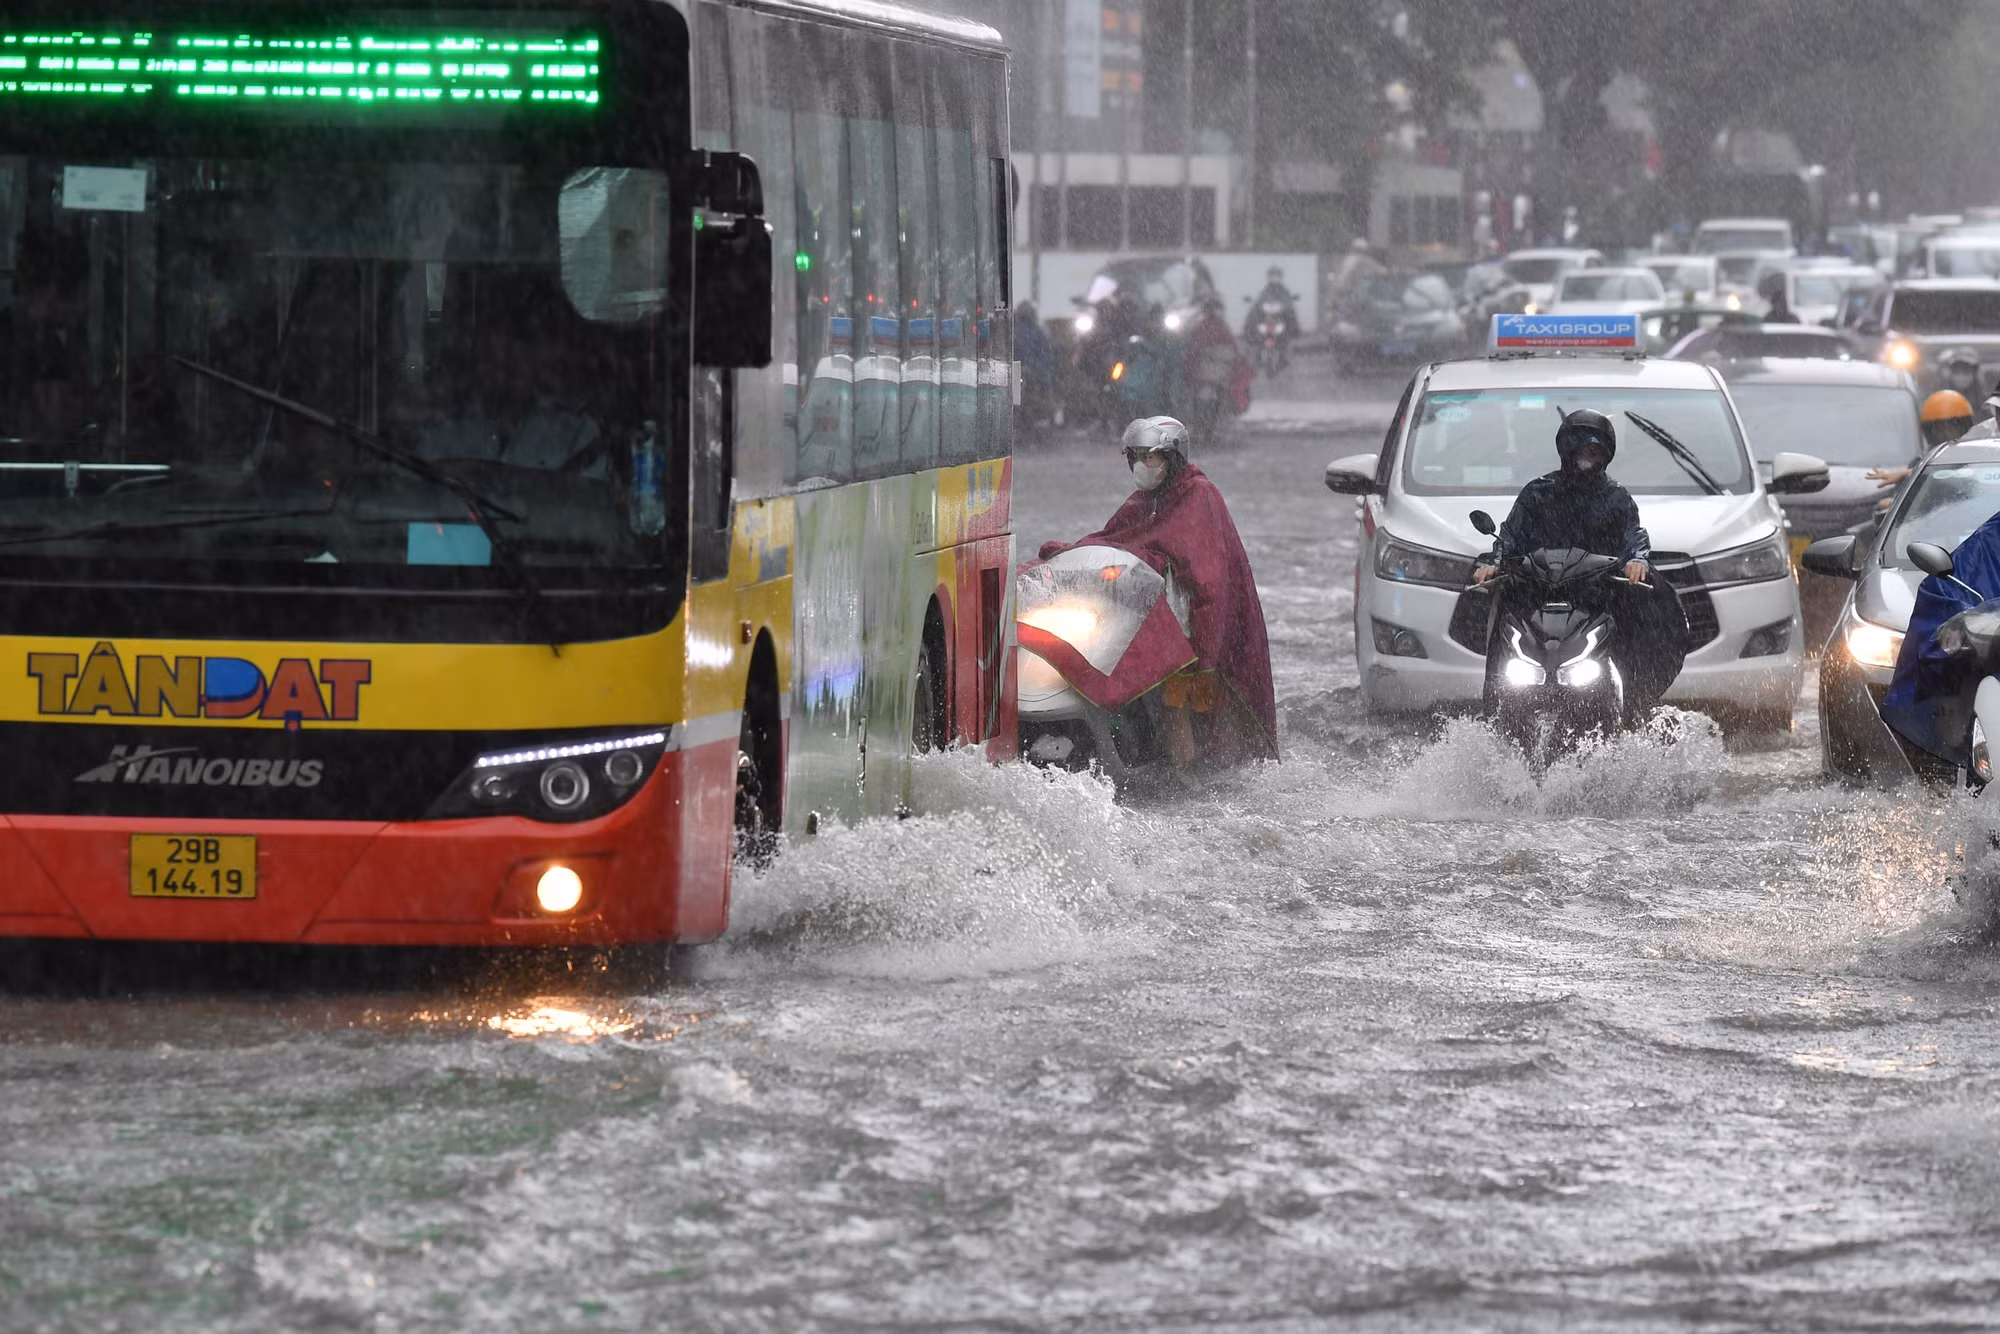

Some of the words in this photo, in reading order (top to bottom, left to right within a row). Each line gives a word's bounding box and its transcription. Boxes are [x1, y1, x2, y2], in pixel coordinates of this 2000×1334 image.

[1515, 323, 1631, 335] TAXIGROUP
[73, 745, 323, 788] HANOIBUS
[166, 838, 221, 865] 29B
[147, 868, 243, 895] 144.19
